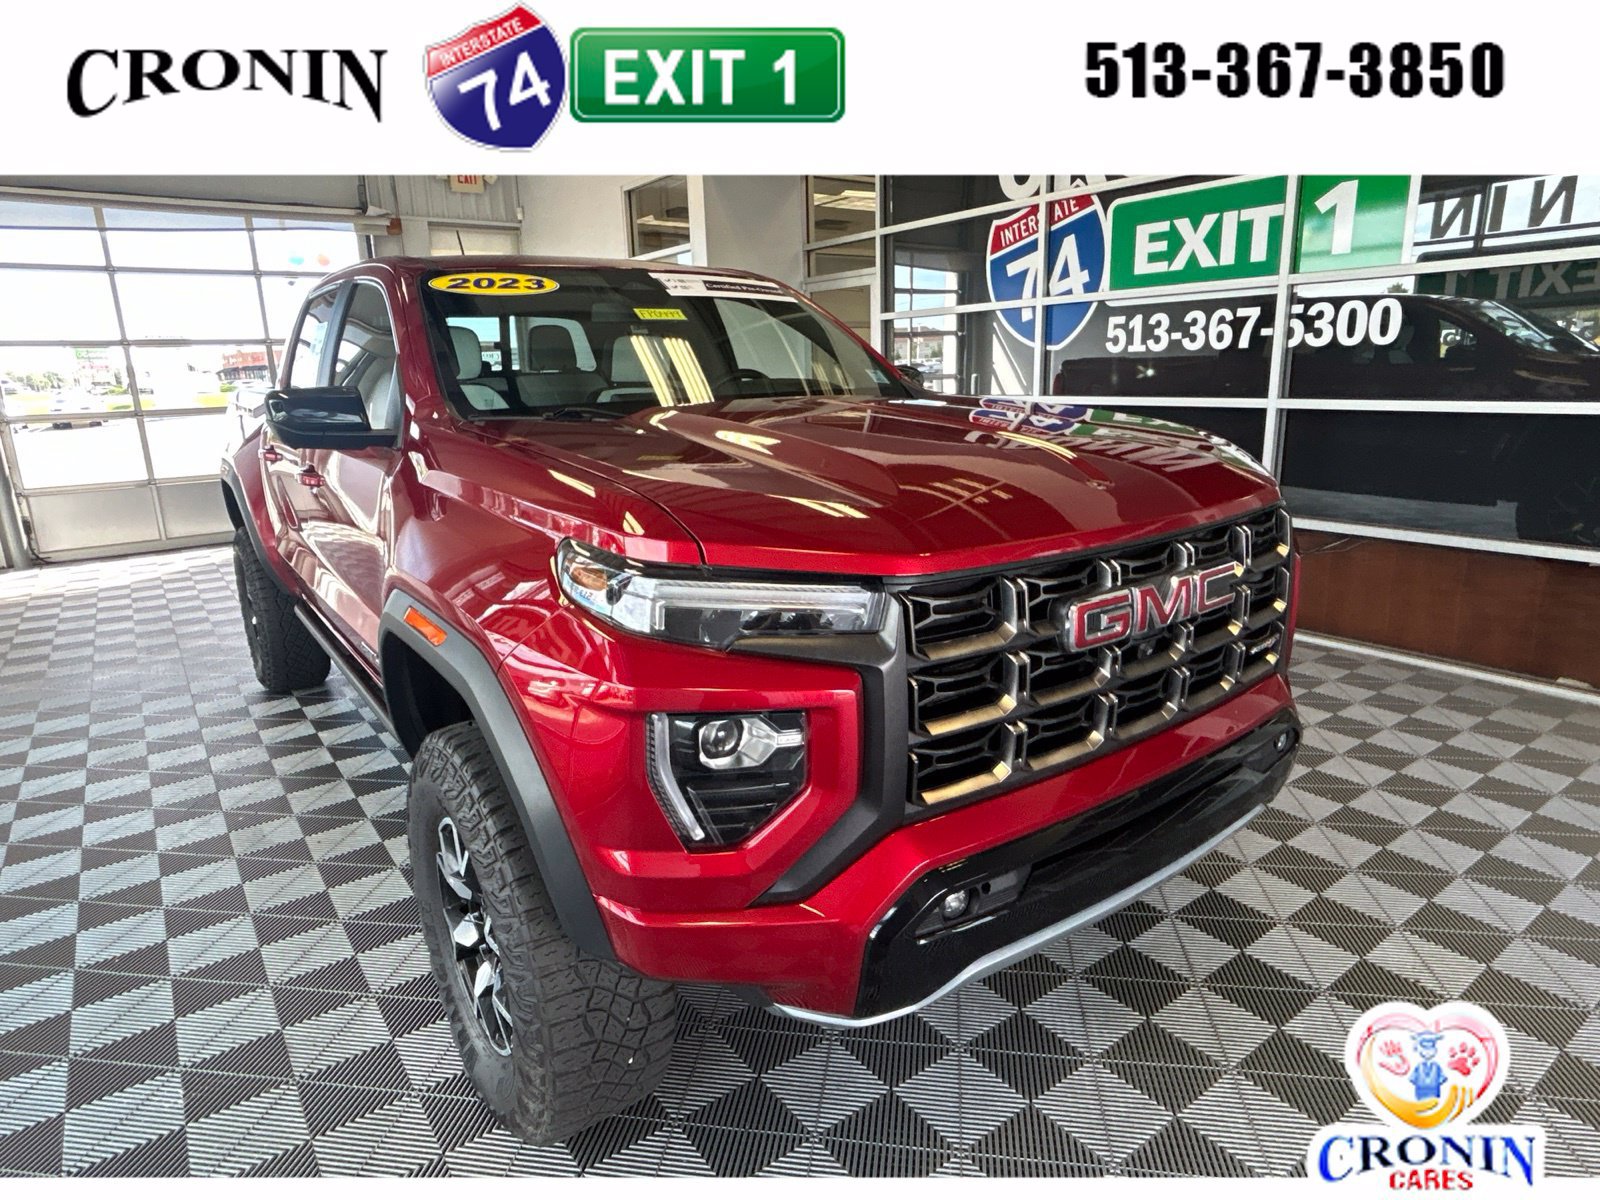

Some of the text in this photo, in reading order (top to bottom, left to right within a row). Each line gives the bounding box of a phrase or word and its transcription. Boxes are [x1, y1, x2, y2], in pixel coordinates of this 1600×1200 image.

[1000, 199, 1079, 247] INTERATE
[1133, 179, 1359, 276] EXIT 1
[446, 277, 547, 290] 2023
[1006, 234, 1091, 323] 74
[1105, 298, 1403, 353] 513-367-5300
[1067, 561, 1239, 652] GMC
